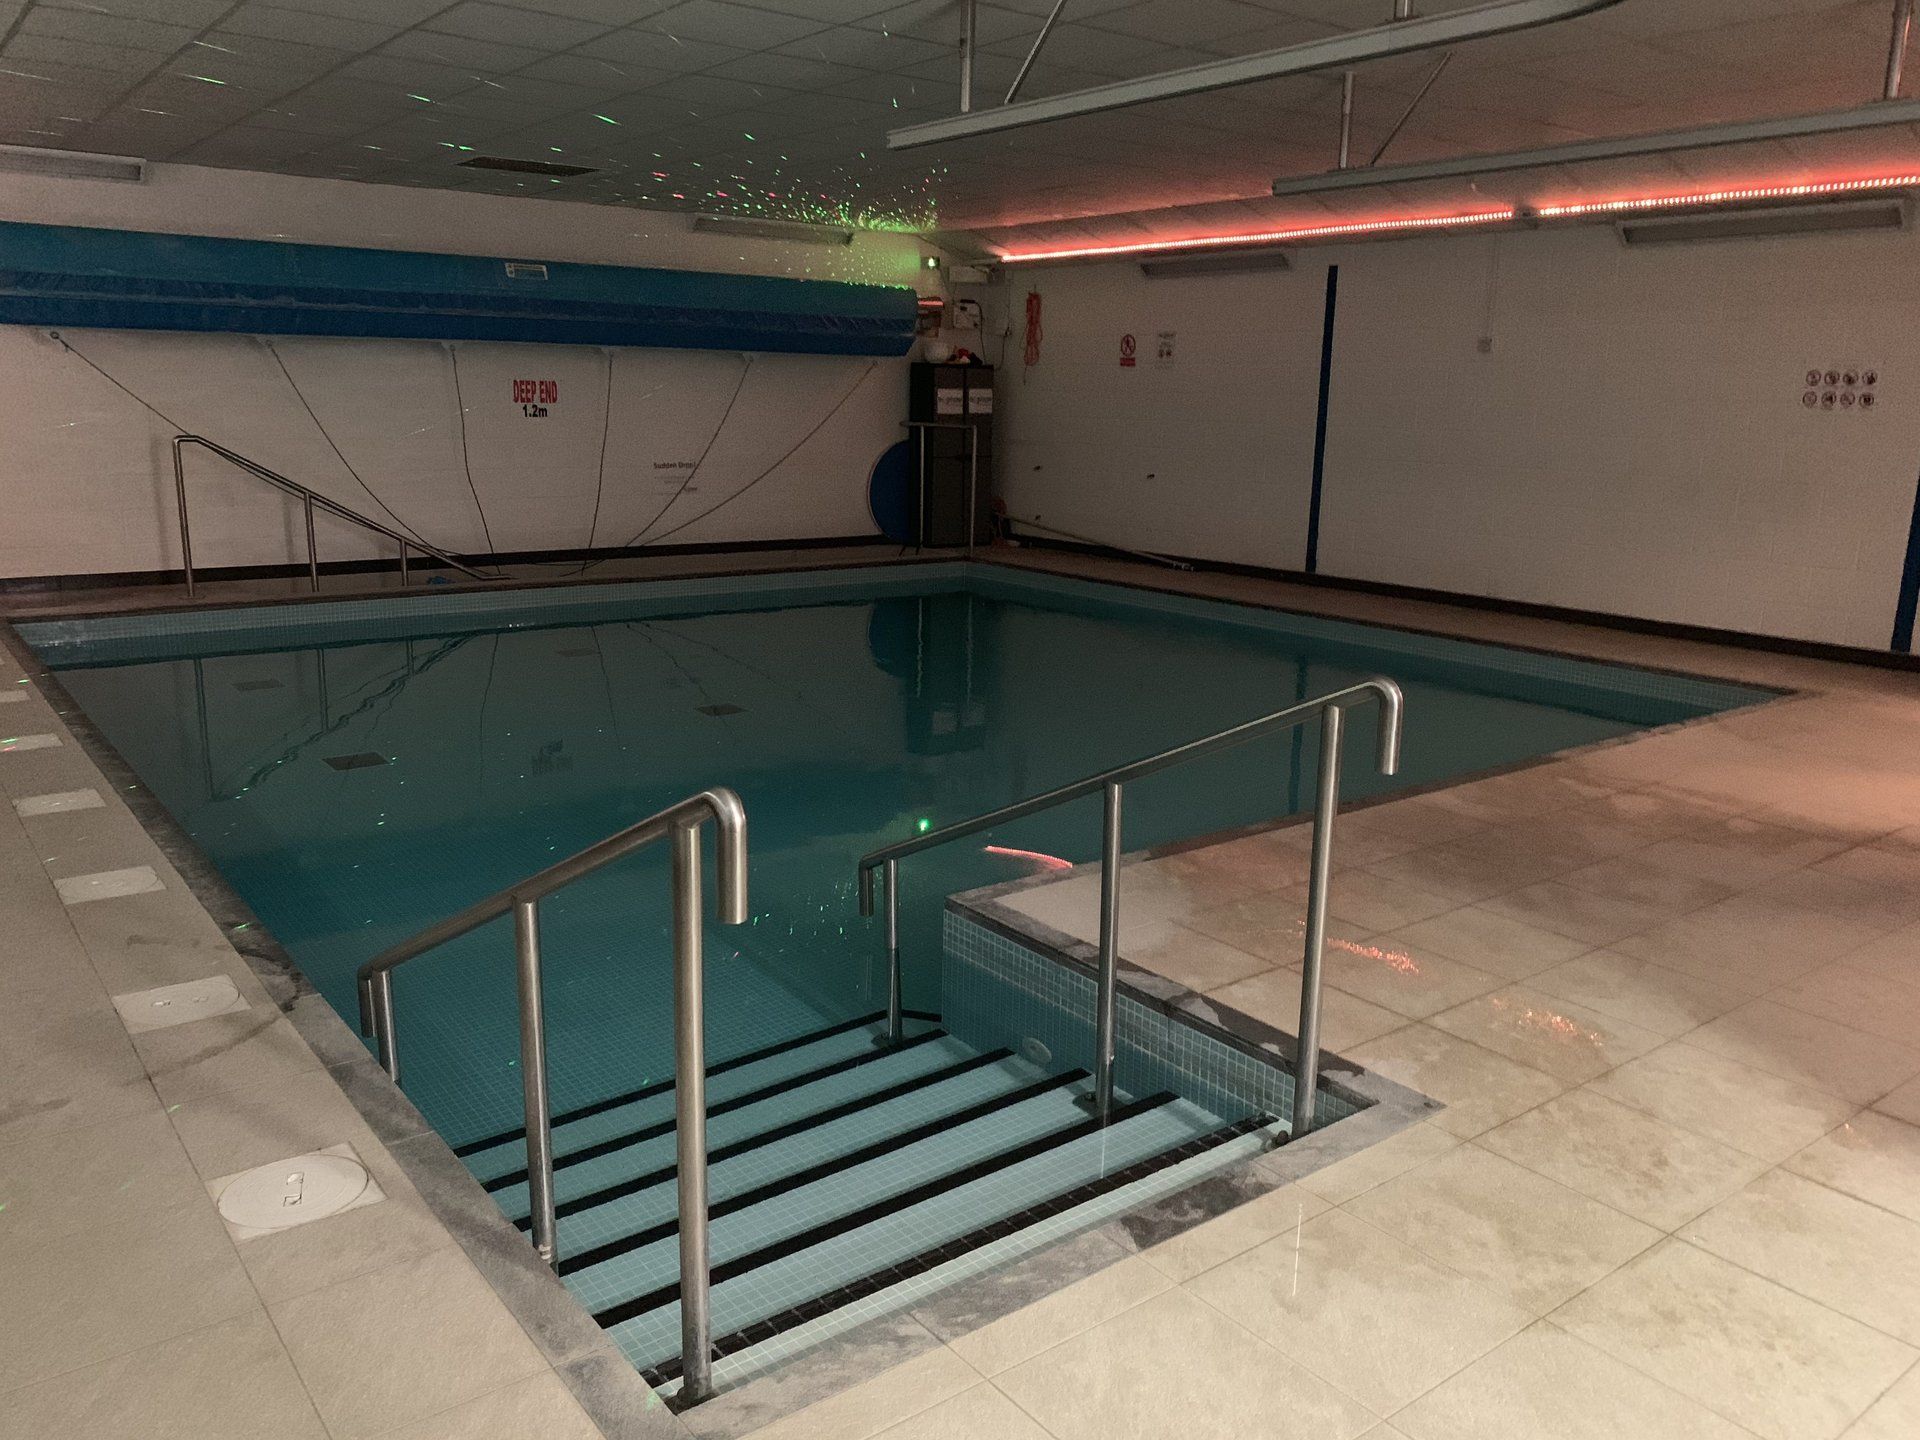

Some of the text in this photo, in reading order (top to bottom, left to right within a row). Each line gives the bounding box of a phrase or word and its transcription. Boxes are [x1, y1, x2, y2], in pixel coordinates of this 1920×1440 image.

[513, 380, 558, 403] DEEP END
[522, 404, 548, 418] 1.2m
